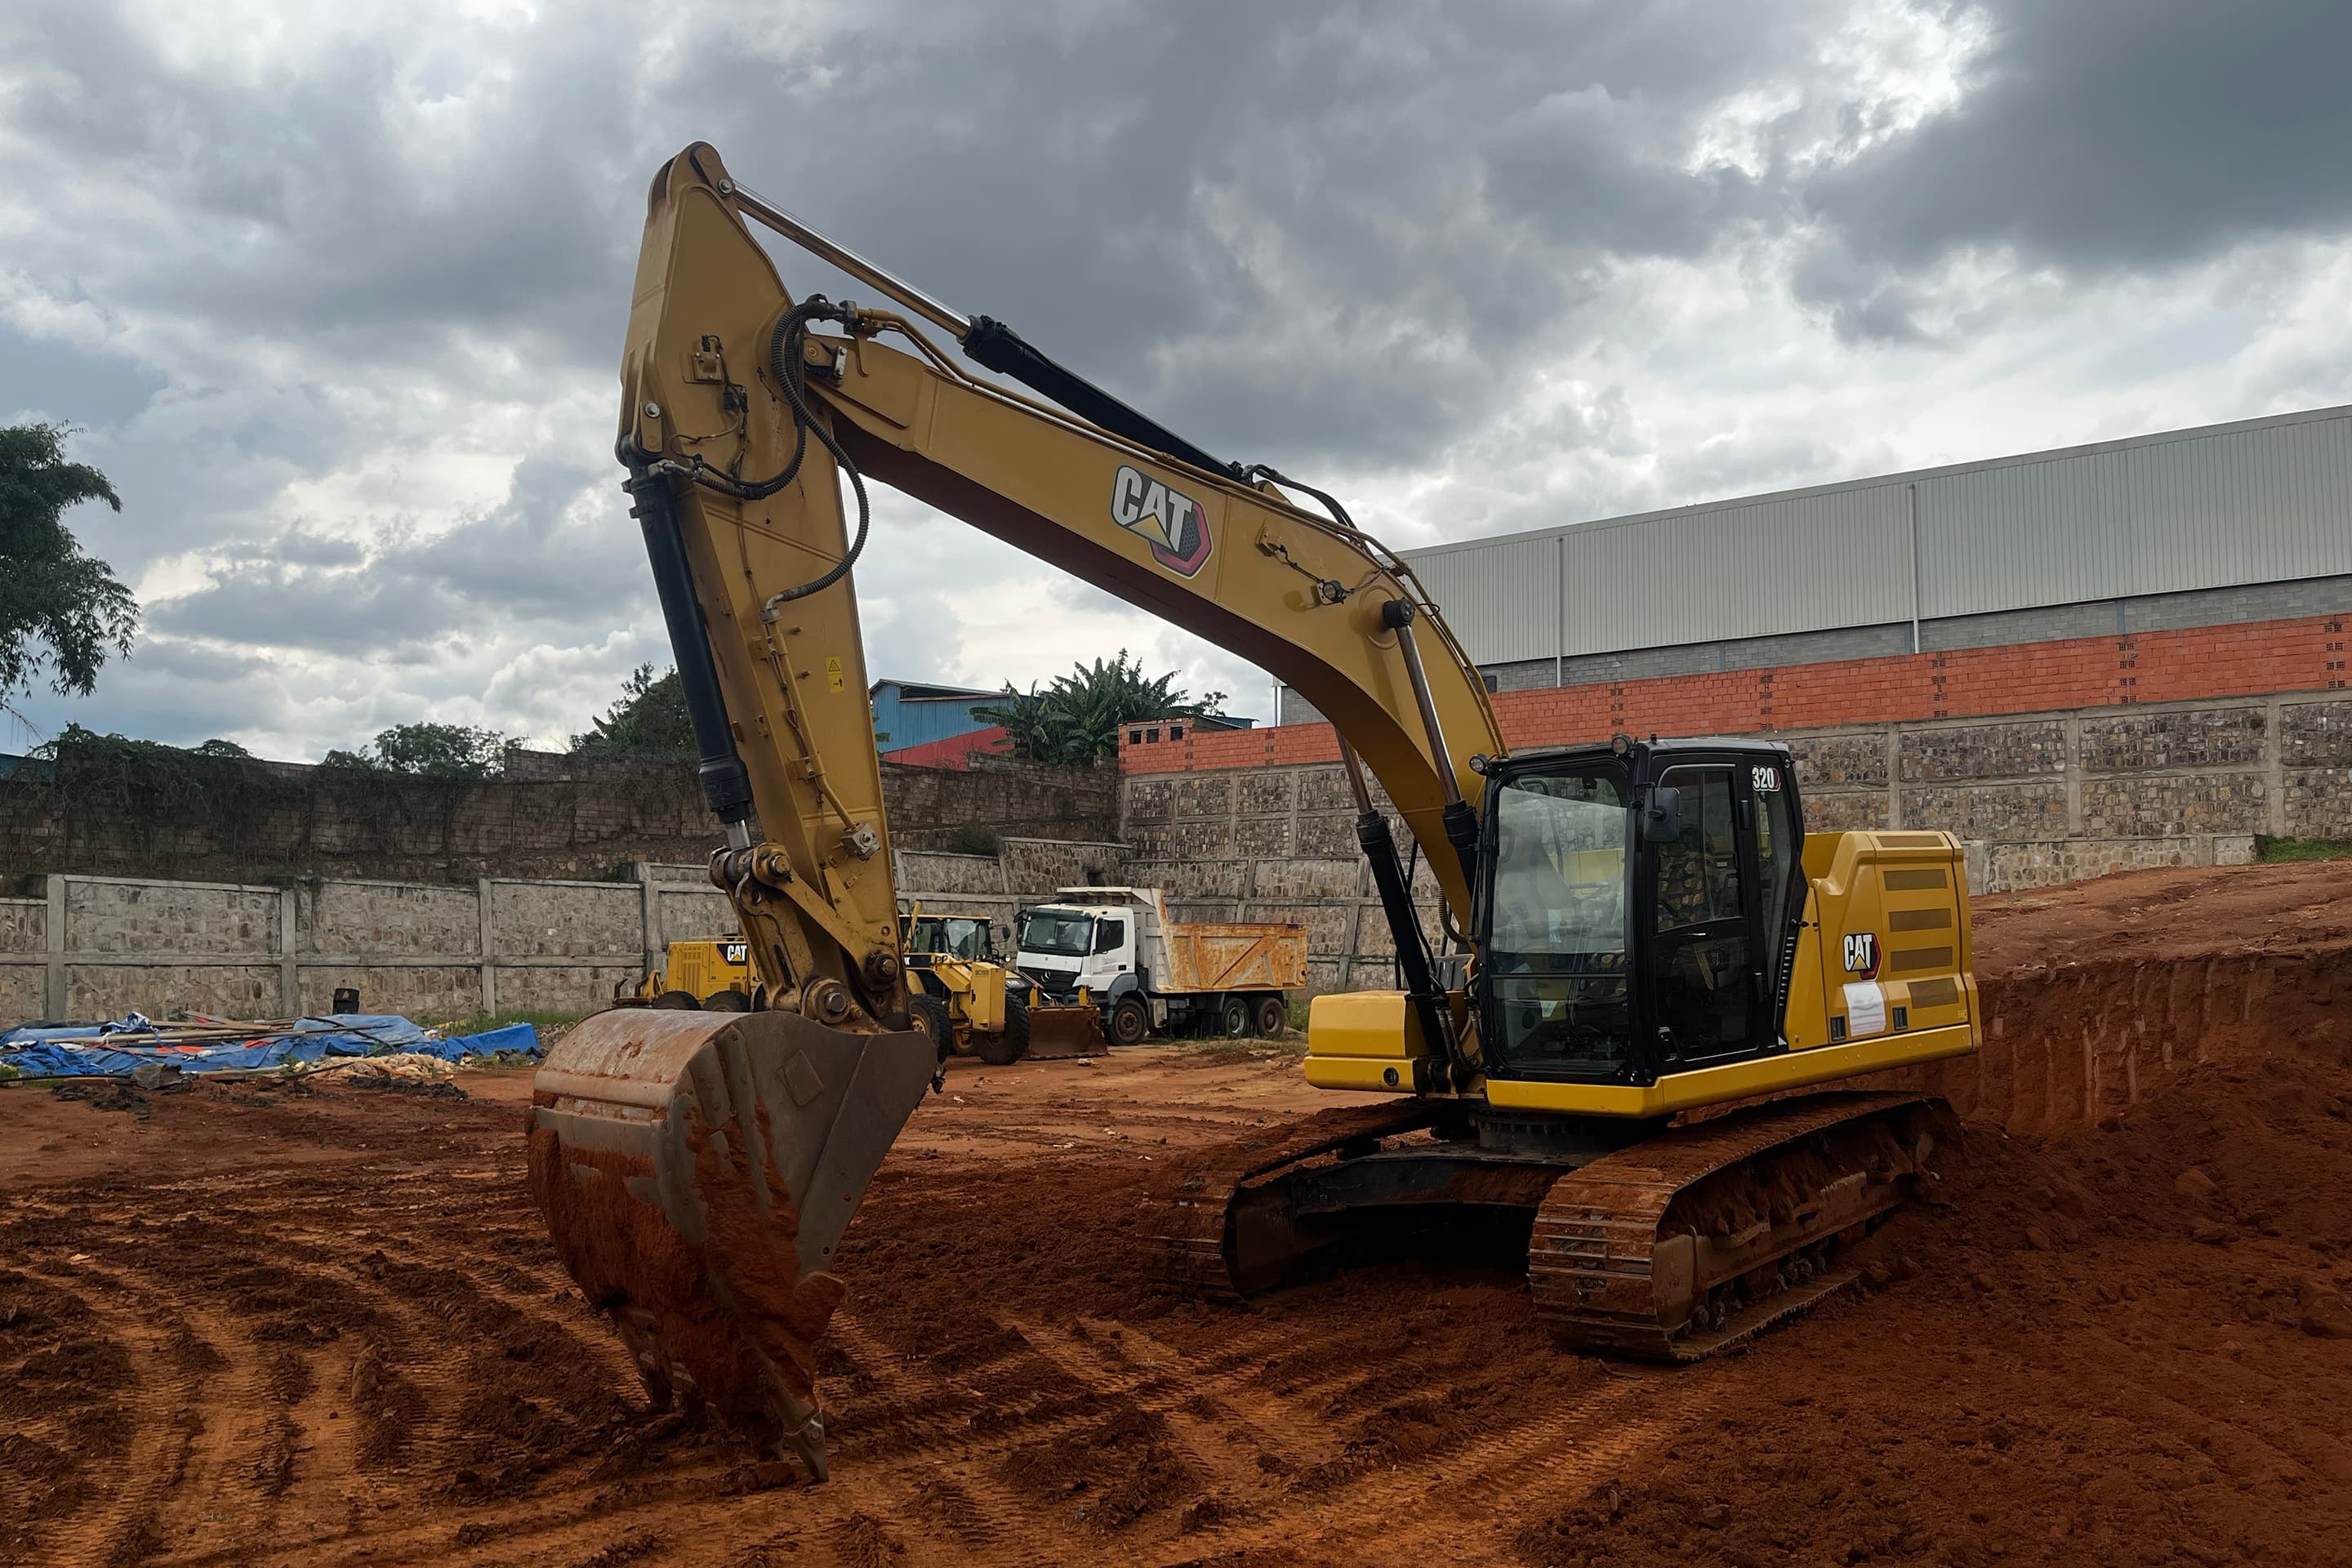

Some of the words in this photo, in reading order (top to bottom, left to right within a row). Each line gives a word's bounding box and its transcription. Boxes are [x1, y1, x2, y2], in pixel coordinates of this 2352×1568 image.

[1112, 466, 1192, 553] CAT
[1752, 767, 1775, 789] 320
[727, 945, 747, 962] CAT
[1843, 934, 1873, 971] CAT
